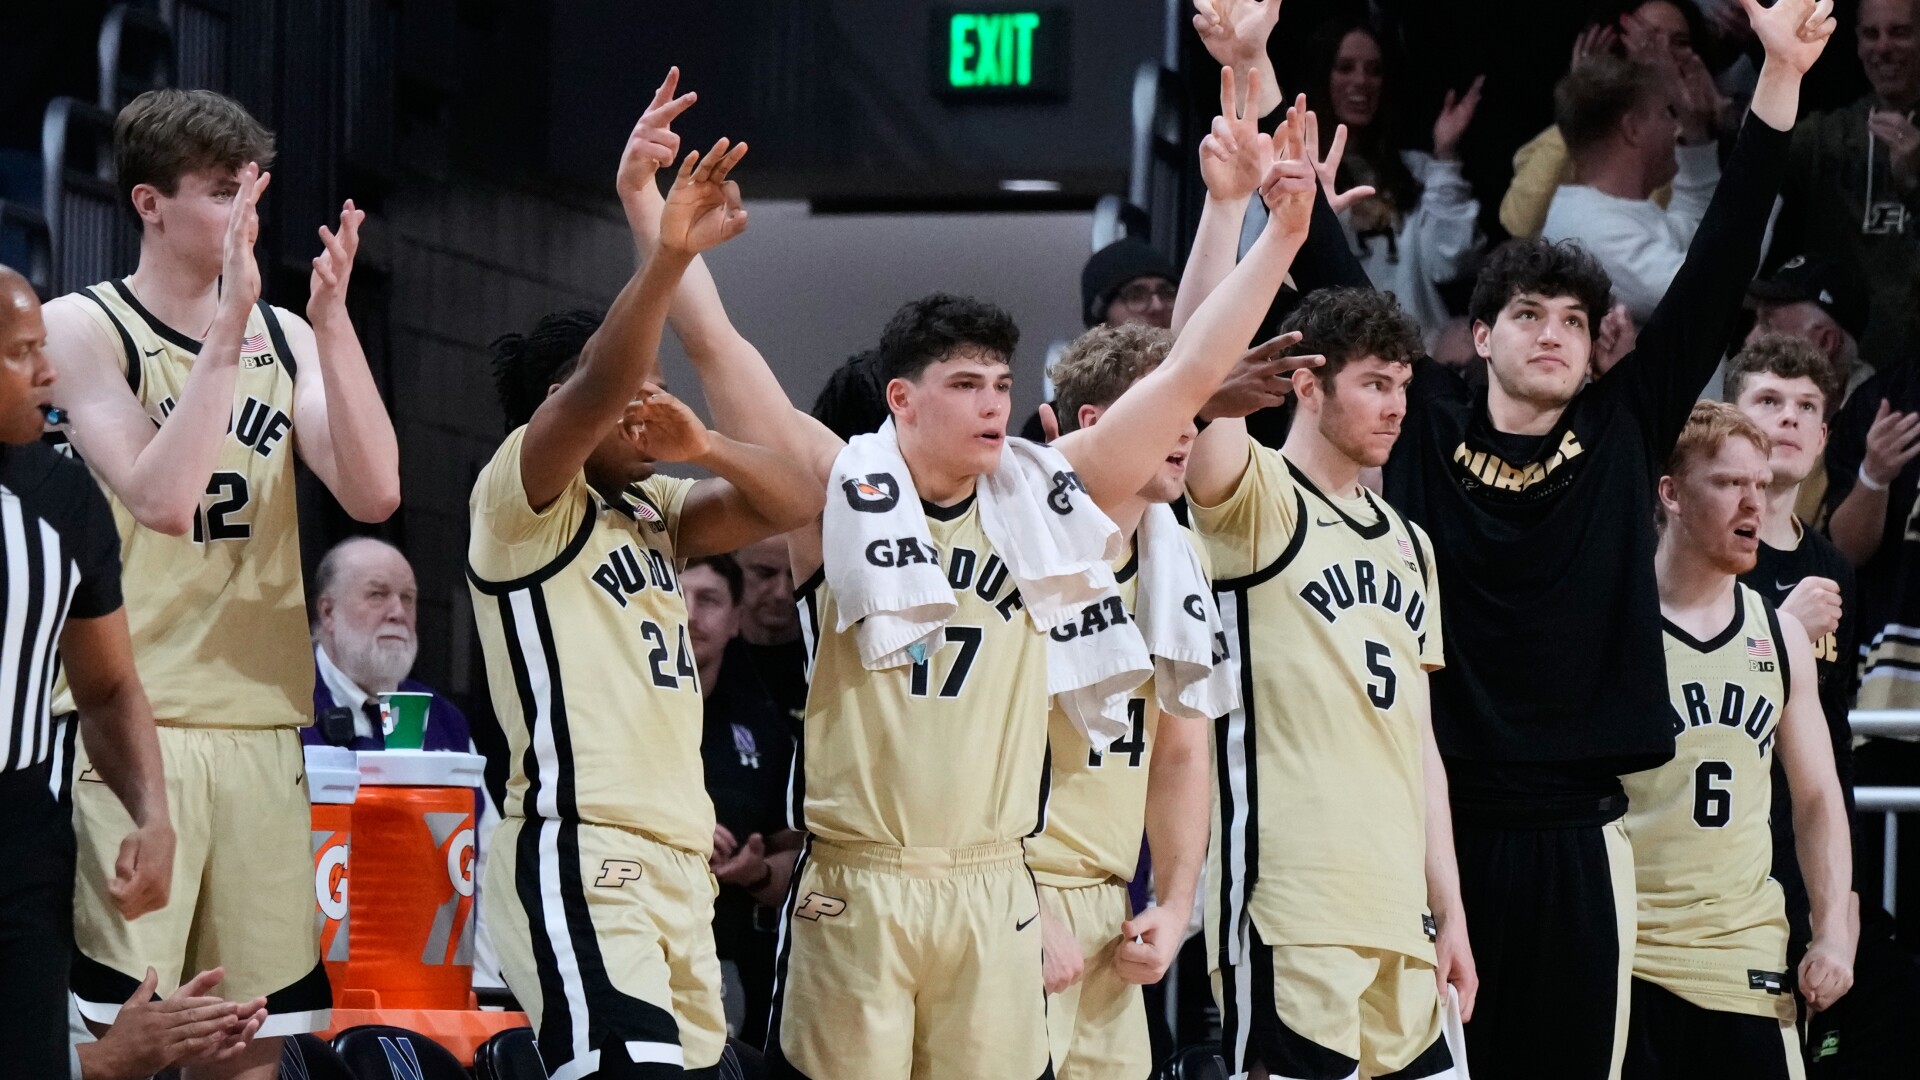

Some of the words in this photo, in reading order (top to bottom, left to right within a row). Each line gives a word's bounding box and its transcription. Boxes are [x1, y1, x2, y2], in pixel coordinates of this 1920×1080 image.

[950, 13, 1039, 86] EXIT
[639, 620, 699, 694] 24
[1363, 638, 1398, 711] 5
[1692, 759, 1734, 830] 6
[315, 843, 350, 921] G
[447, 828, 476, 898] G
[594, 859, 643, 889] P
[795, 891, 848, 922] P
